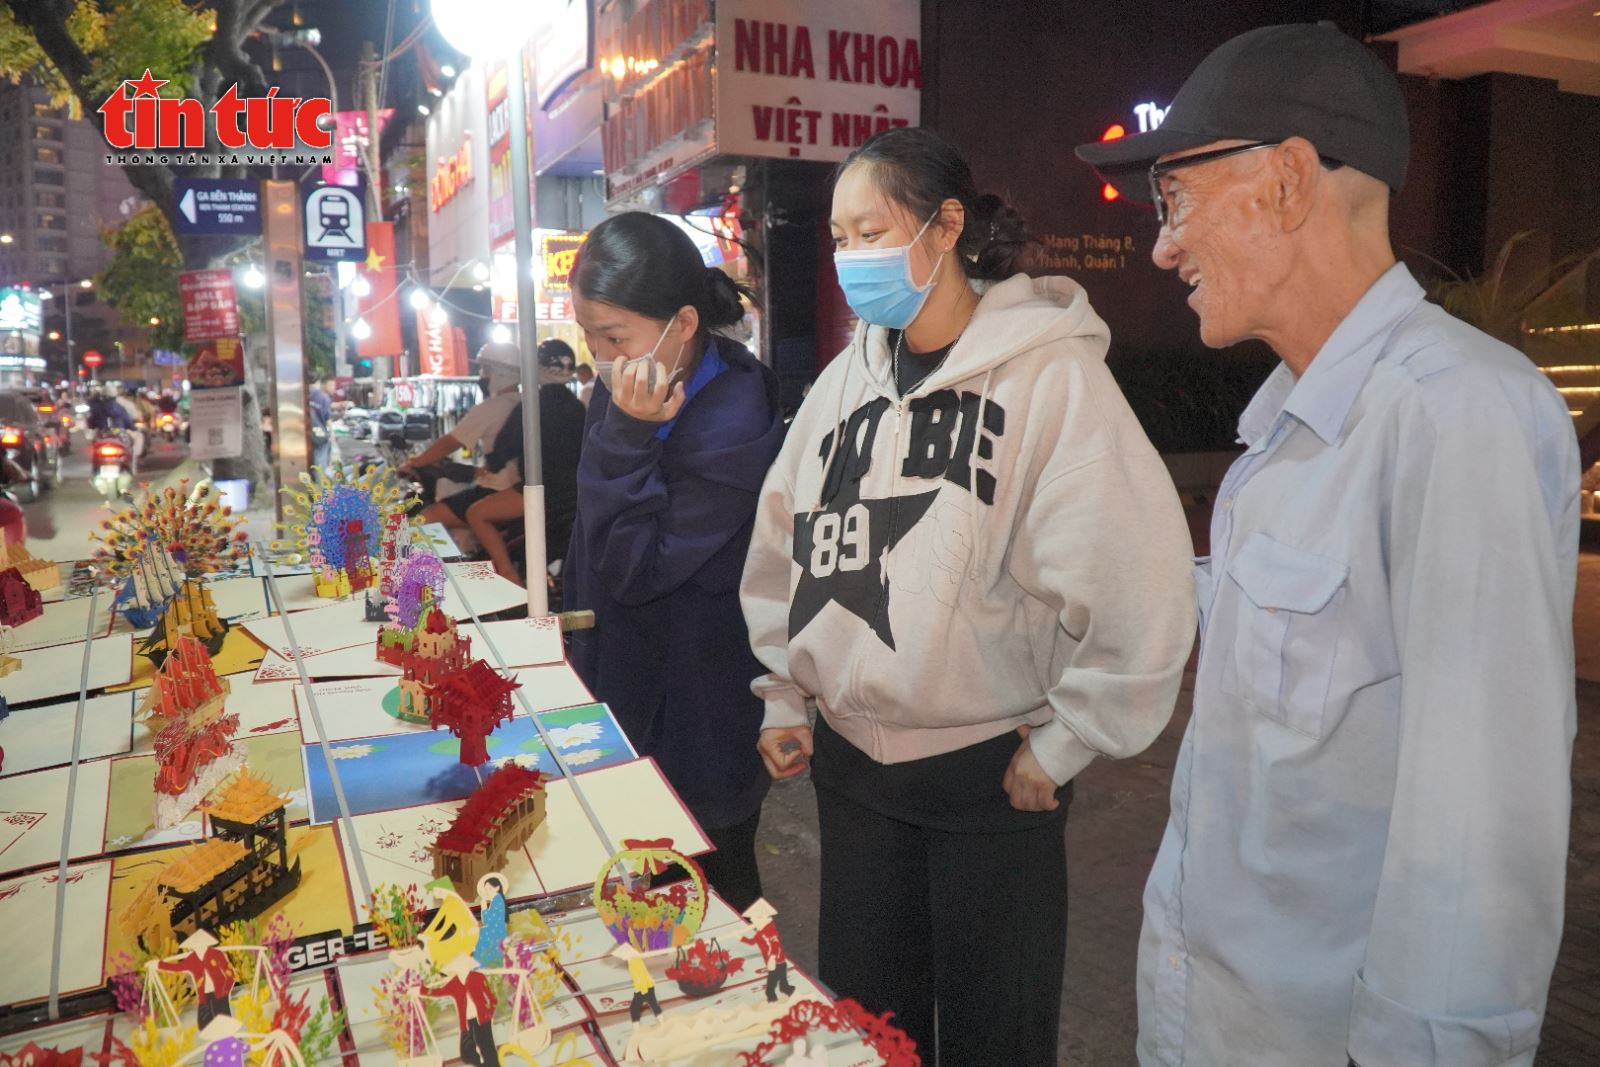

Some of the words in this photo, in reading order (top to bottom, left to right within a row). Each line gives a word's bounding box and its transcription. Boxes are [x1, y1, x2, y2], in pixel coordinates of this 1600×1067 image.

[734, 18, 815, 79] NHA
[828, 29, 922, 90] KHOA
[752, 96, 822, 157] VIỆT
[1133, 101, 1172, 133] Th
[196, 191, 209, 201] GA
[217, 213, 233, 223] 550
[811, 503, 870, 578] 89
